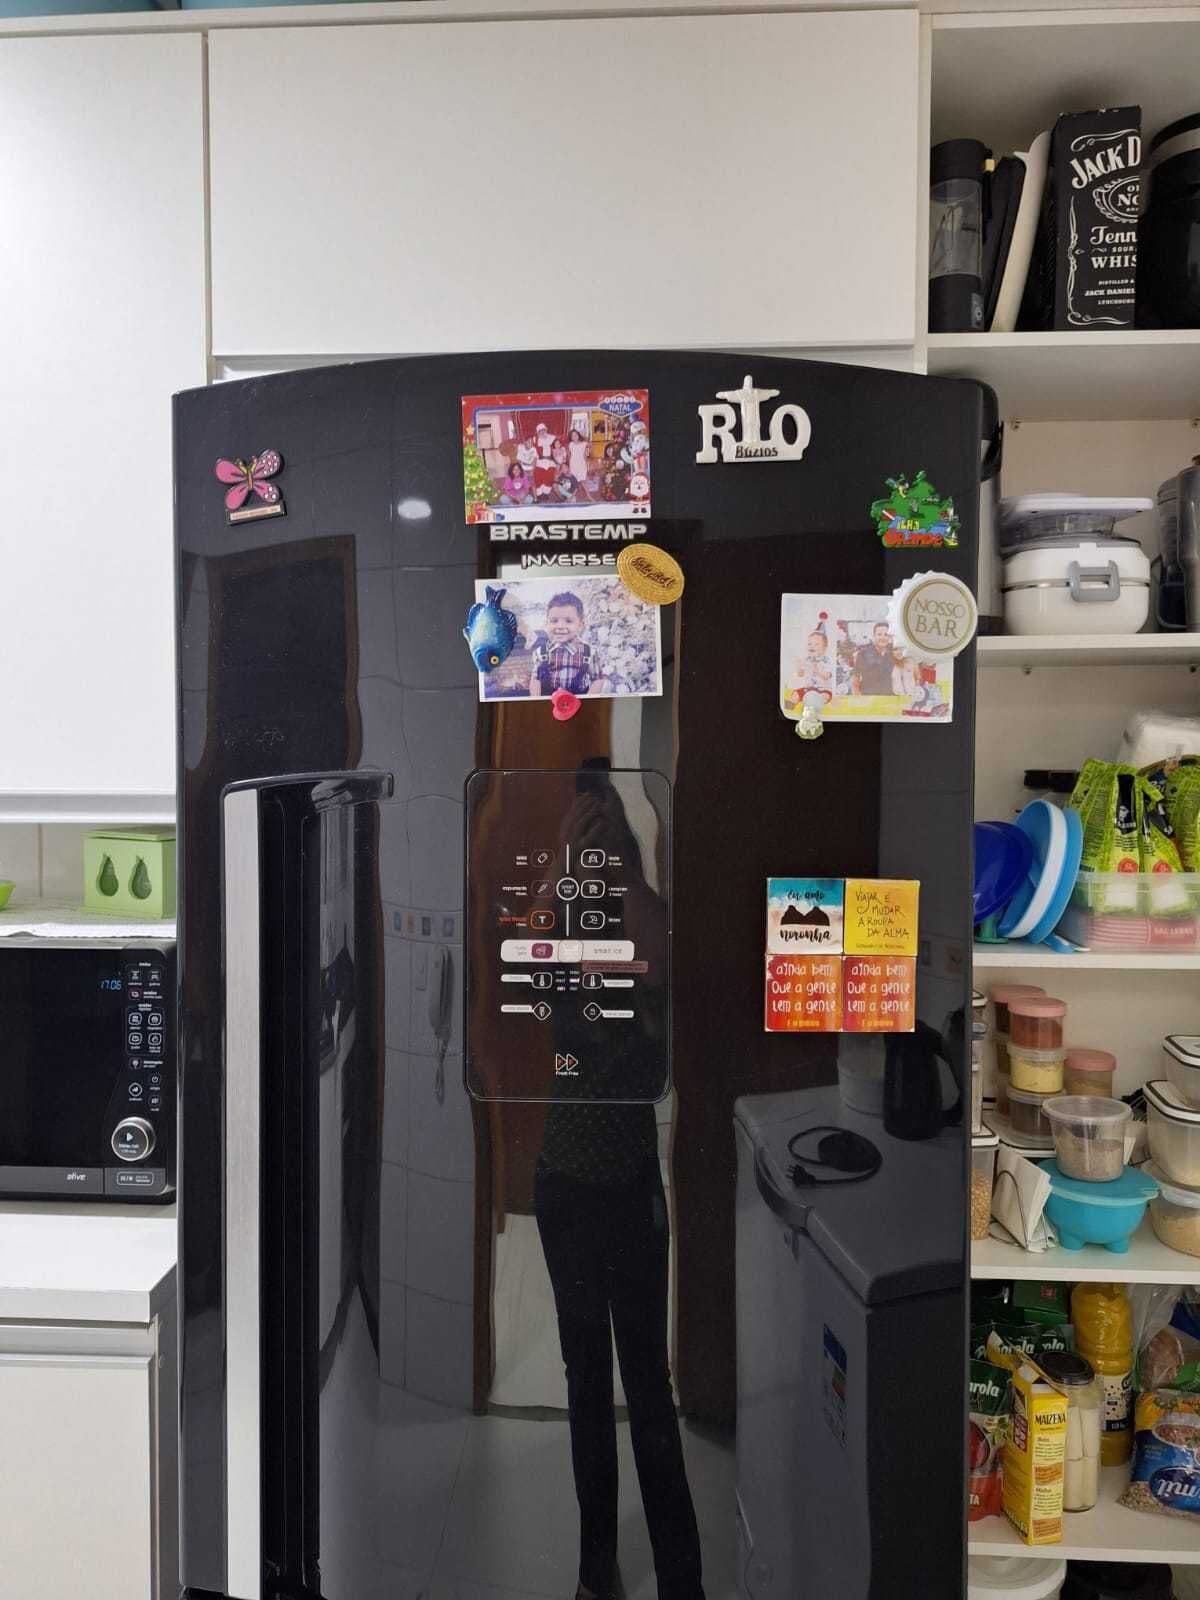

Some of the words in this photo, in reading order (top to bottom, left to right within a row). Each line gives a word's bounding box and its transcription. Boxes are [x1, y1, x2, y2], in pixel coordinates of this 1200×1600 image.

[1070, 144, 1125, 188] JACK
[489, 524, 647, 541] BRASTEMP
[914, 598, 967, 618] NOSSO
[915, 614, 958, 639] BAR
[794, 983, 803, 993] a
[806, 981, 837, 996] gente
[870, 983, 878, 993] a
[881, 982, 911, 996] gente
[794, 1001, 802, 1012] a
[806, 999, 836, 1014] gente
[869, 1001, 876, 1012] a
[880, 1000, 910, 1014] gente
